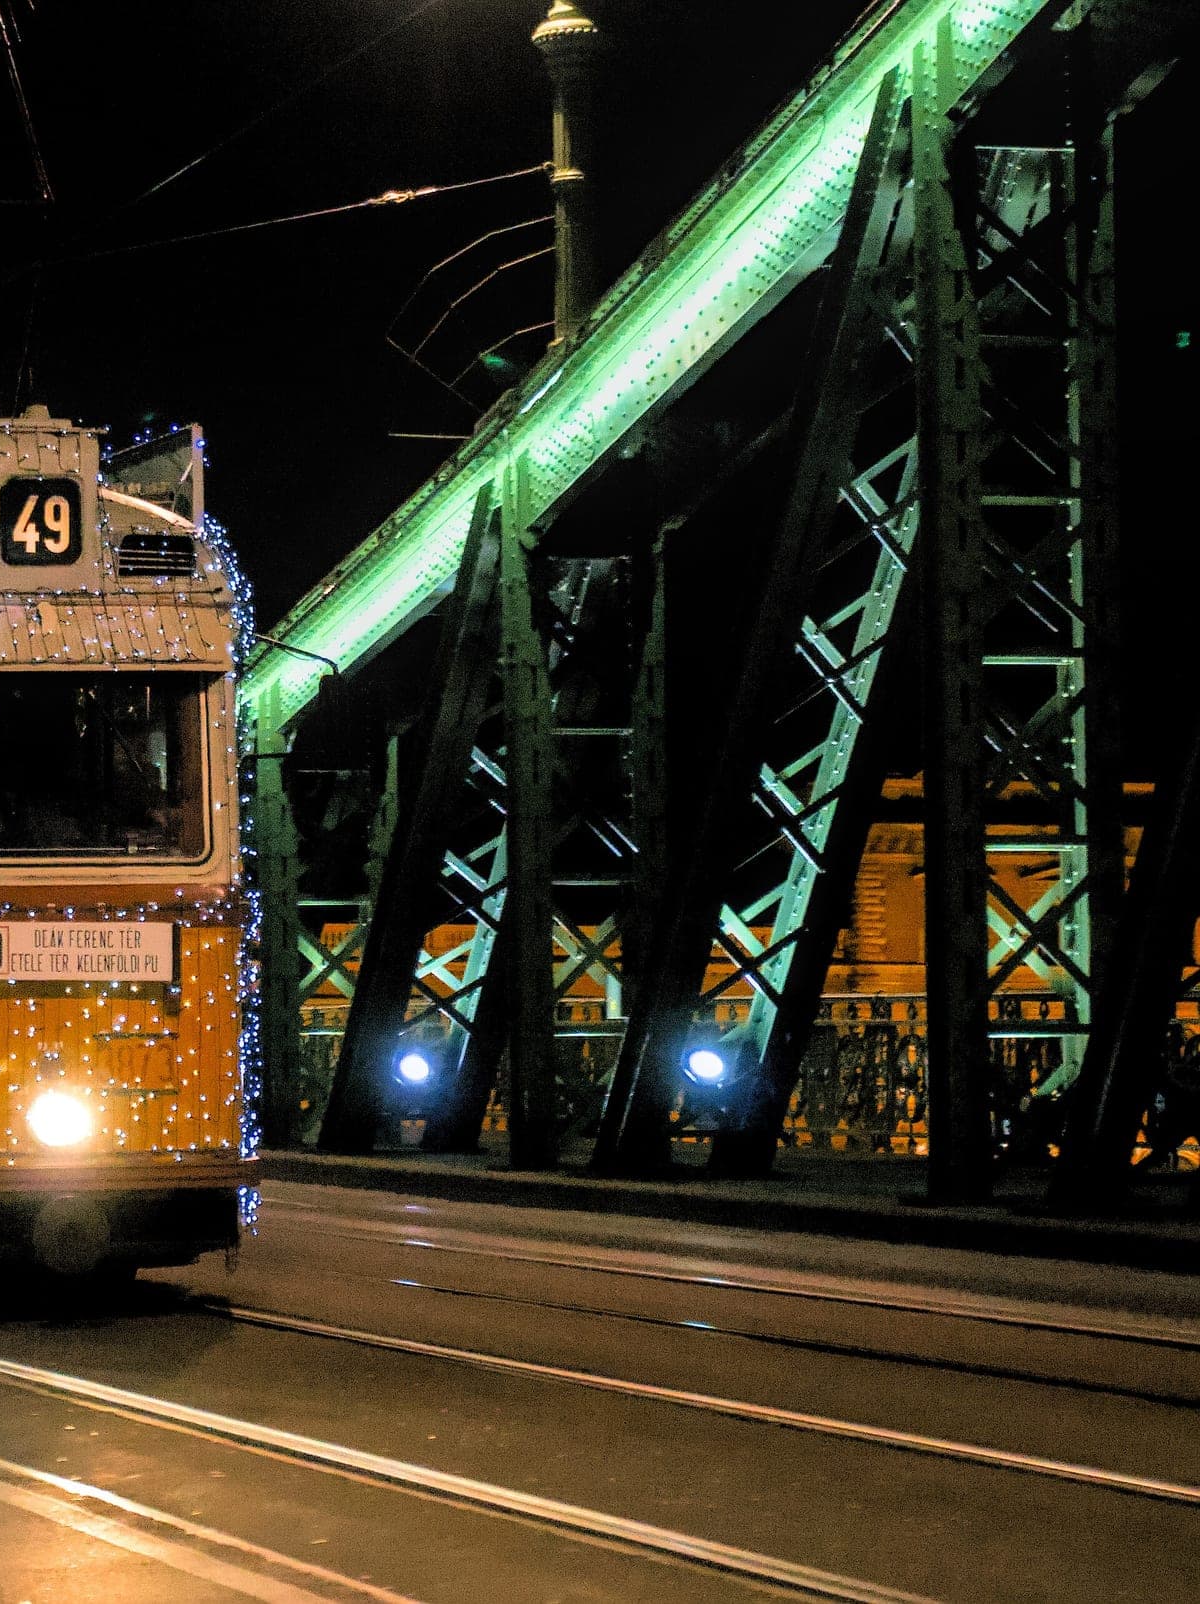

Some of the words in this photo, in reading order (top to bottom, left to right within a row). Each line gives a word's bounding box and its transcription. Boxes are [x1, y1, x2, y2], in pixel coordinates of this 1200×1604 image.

[12, 494, 71, 554] 49
[34, 926, 64, 949] DEÁK
[69, 929, 114, 949] FERENC
[119, 926, 141, 949] TÉR
[11, 953, 43, 973] ETELE
[77, 951, 140, 973] KELENFÖLDI
